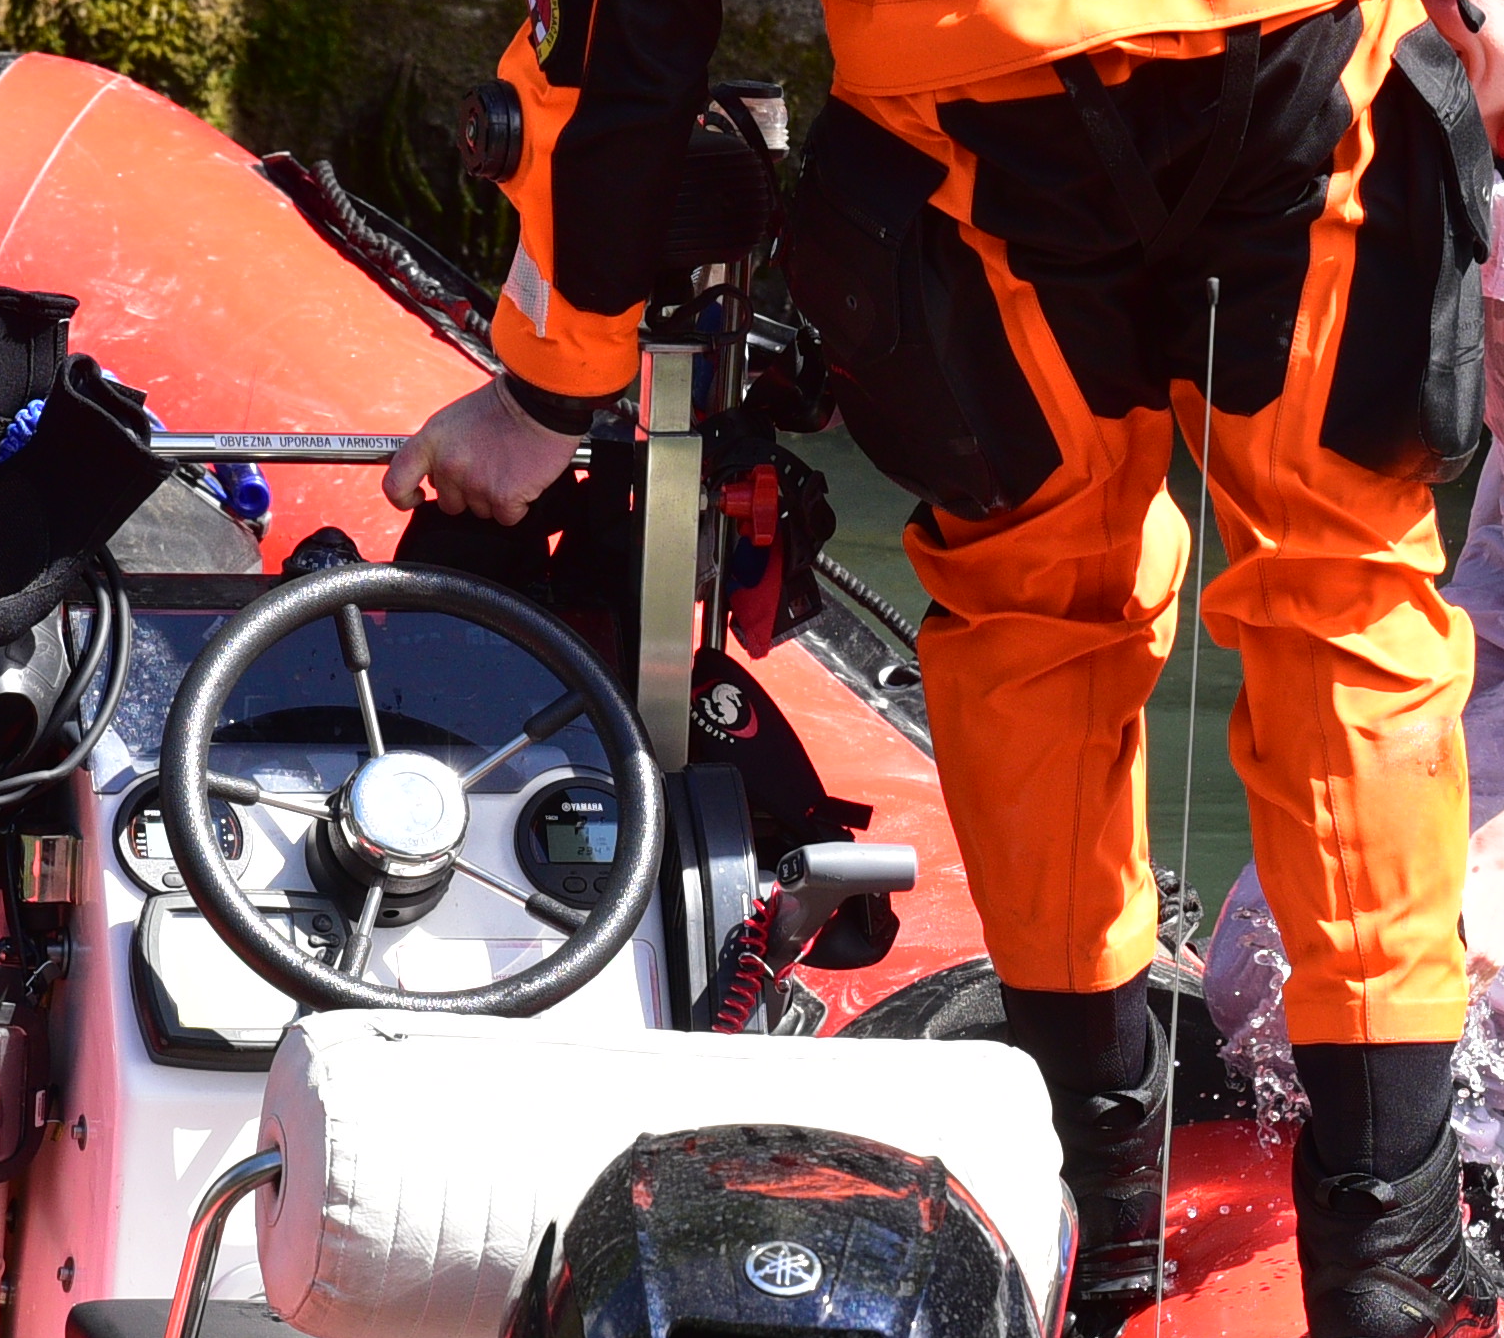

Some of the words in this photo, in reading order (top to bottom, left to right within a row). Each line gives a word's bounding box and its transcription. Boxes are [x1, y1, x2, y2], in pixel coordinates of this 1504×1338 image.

[220, 436, 272, 448] OBVEZNA
[279, 436, 332, 449] UPORABA
[571, 803, 603, 811] YAMAHA
